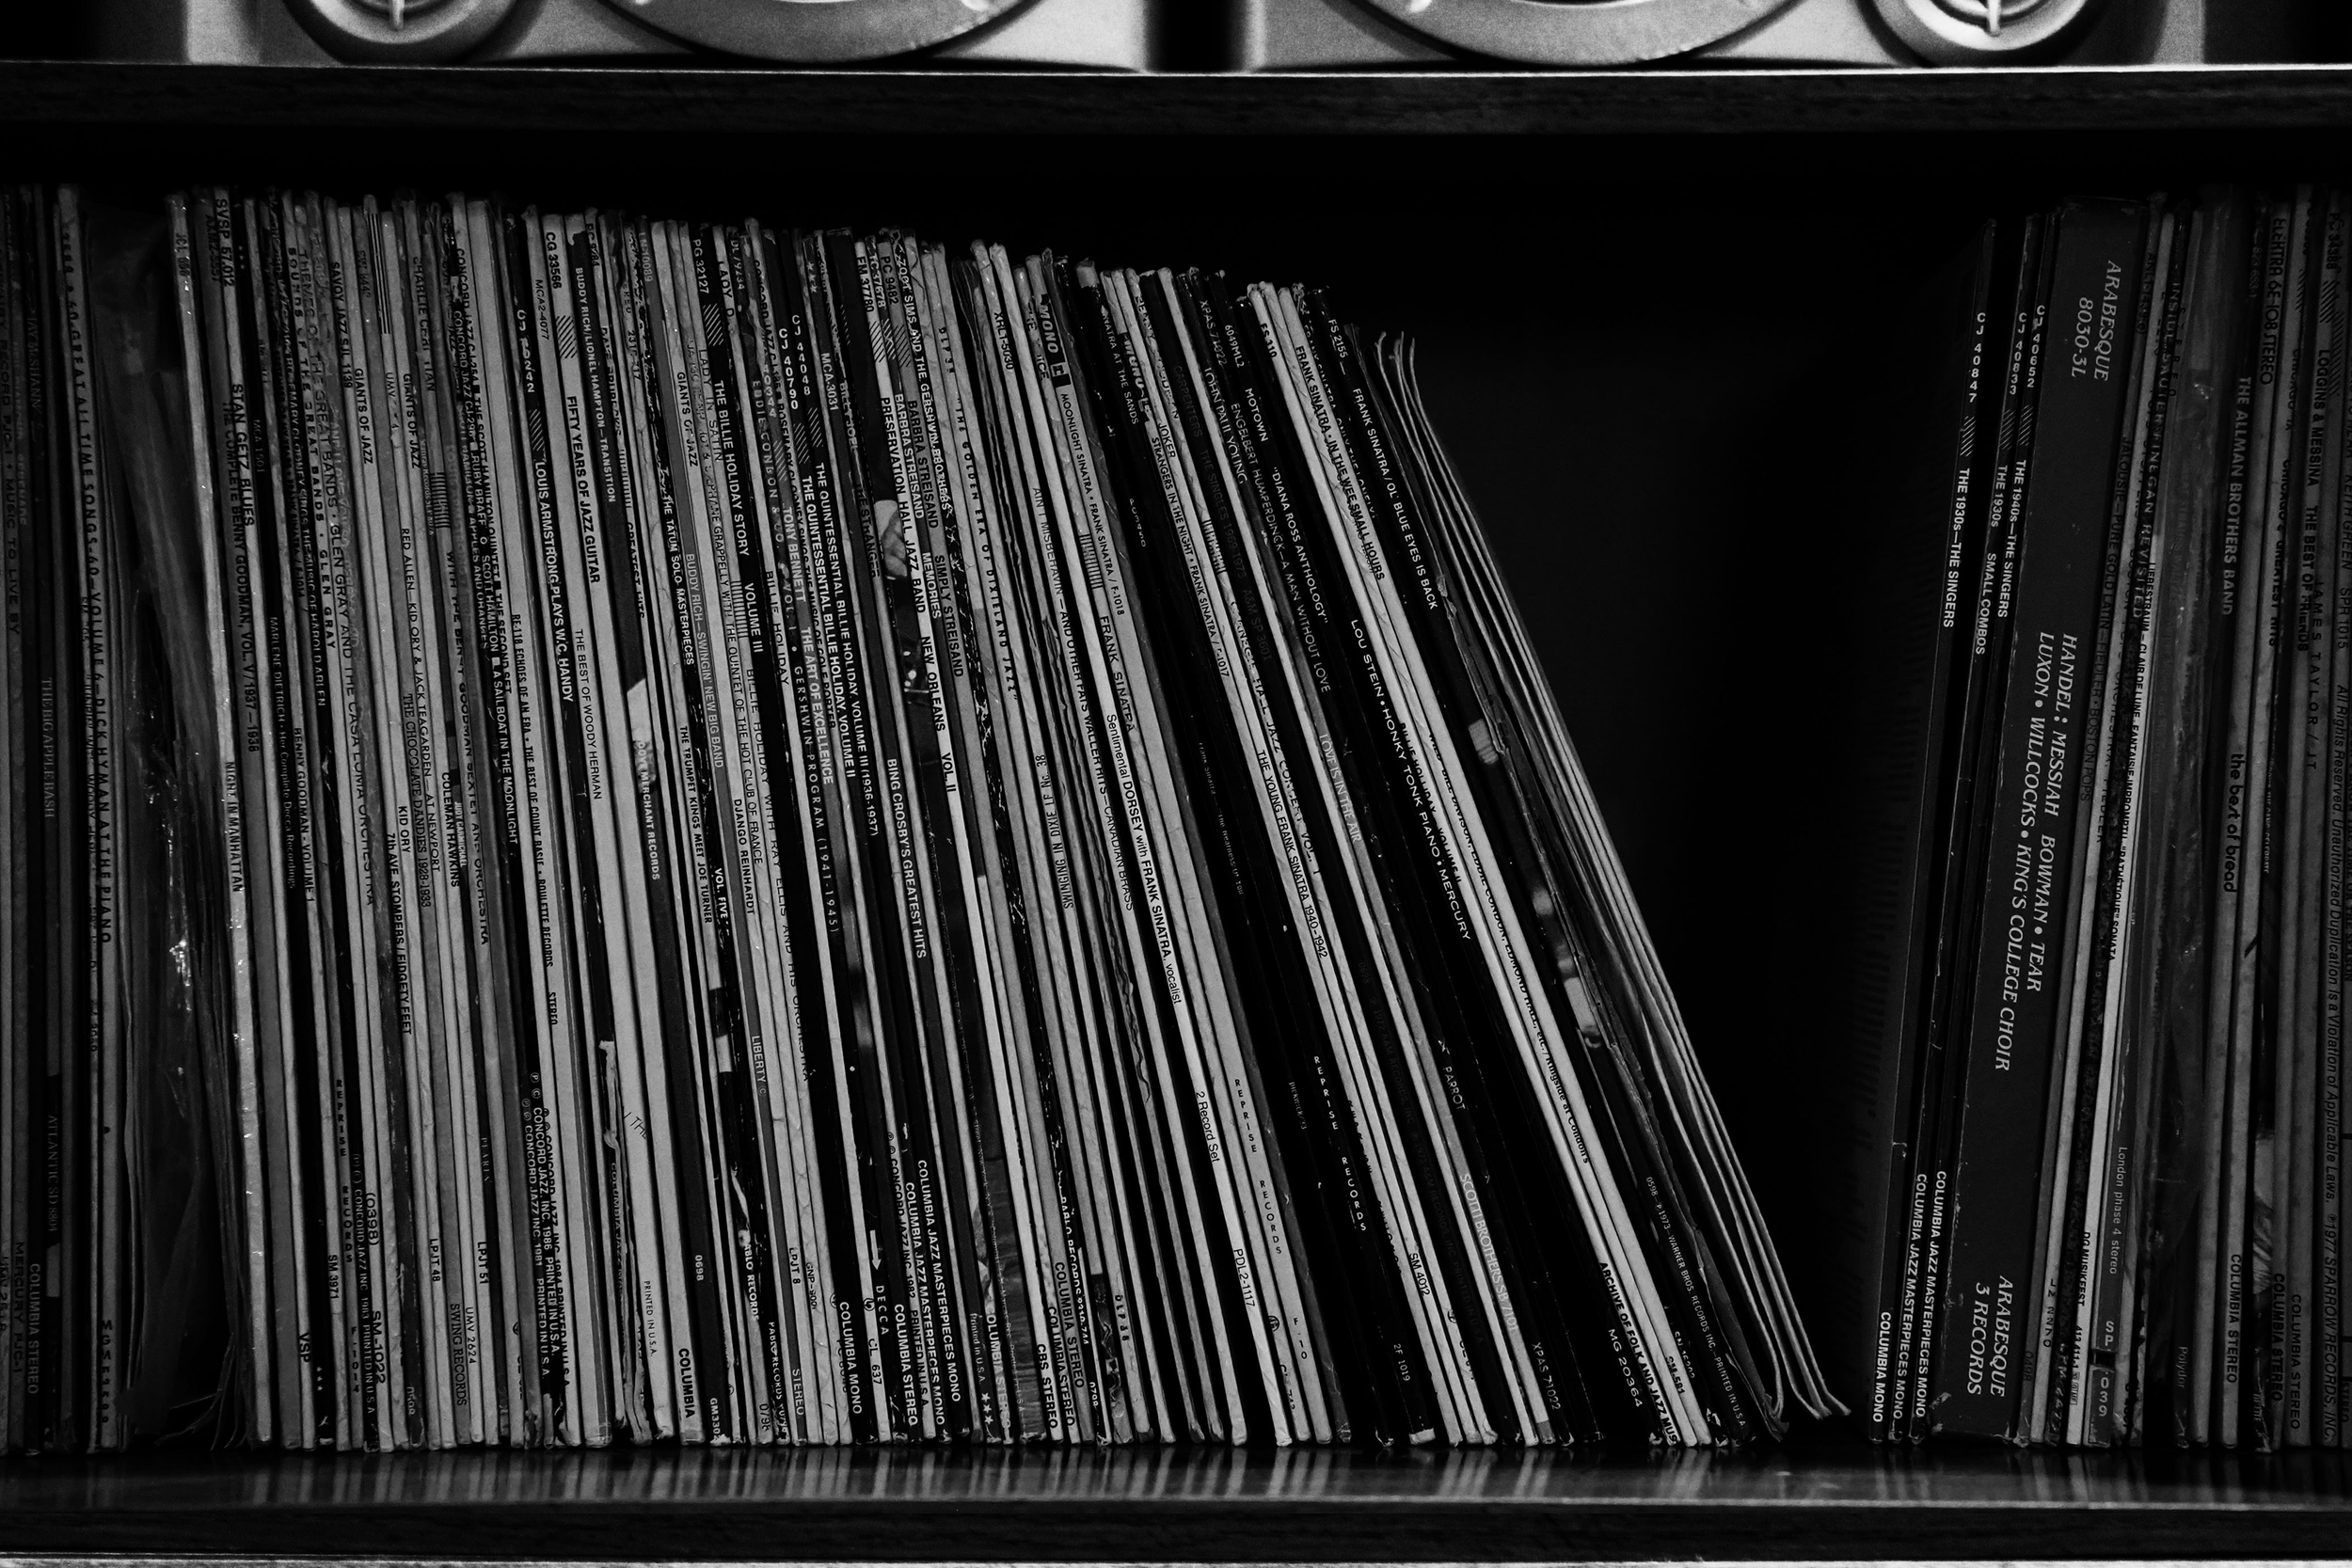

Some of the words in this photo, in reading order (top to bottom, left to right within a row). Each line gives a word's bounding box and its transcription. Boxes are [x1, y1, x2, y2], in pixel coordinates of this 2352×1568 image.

[544, 230, 558, 251] CG
[691, 238, 704, 258] PG
[328, 261, 345, 302] SAVOY
[547, 253, 564, 290] 33566
[693, 259, 709, 294] 32127
[333, 305, 348, 335] JAZZ
[2069, 296, 2094, 378] 8030-3L
[2091, 260, 2122, 382] ARABESQUE
[336, 337, 351, 360] SJL
[339, 362, 354, 388] 1139
[353, 367, 369, 413] GIANTS
[712, 379, 728, 407] THE
[2235, 375, 2251, 405] THE
[2312, 348, 2330, 410] LOGGINS
[230, 383, 246, 423] STAN
[358, 415, 371, 432] OF
[565, 395, 581, 431] FIFTY
[1350, 388, 1374, 426] FRANK
[2311, 413, 2326, 422] &
[717, 409, 735, 450] BILLIE
[879, 396, 906, 493] PRESERVATION
[906, 400, 926, 450] BARBRA
[2230, 408, 2249, 477] ALLMAN
[234, 431, 250, 469] GETZ
[359, 434, 373, 464] JAZZ
[570, 433, 587, 476] YEARS
[1364, 428, 1391, 475] SINATRA
[2306, 425, 2325, 486] MESSINA
[533, 461, 549, 499] LOUIS
[576, 478, 590, 498] OF
[723, 451, 742, 505] HOLIDAY
[812, 462, 828, 487] THE
[914, 451, 940, 528] STREISAND
[2011, 458, 2026, 485] THE
[238, 477, 255, 526] BLUES
[579, 499, 595, 532] JAZZ
[897, 499, 913, 532] HALL
[1391, 501, 1411, 531] BLUE
[2223, 482, 2243, 563] BROTHERS
[538, 500, 560, 583] ARMSTRONG
[731, 507, 750, 556] STORY
[781, 507, 797, 541] TONY
[817, 489, 845, 597] QUINTESSENTIAL
[583, 534, 601, 583] GUITAR
[903, 539, 919, 571] JAZZ
[1402, 533, 1422, 562] EYES
[1412, 563, 1427, 575] IS
[787, 543, 807, 602] BENNETT
[932, 554, 952, 601] SIMPLY
[1417, 578, 1439, 610] BACK
[1996, 562, 2014, 618] SINGERS
[2218, 568, 2236, 615] BAND
[548, 585, 564, 626] PLAYS
[742, 581, 761, 636] VOLUME
[910, 577, 927, 613] BAND
[267, 615, 282, 668] MARLENE
[573, 628, 586, 651] THE
[799, 626, 815, 652] THE
[834, 599, 850, 641] BILLIE
[941, 604, 965, 677] STREISAND
[576, 653, 590, 680] BEST
[751, 640, 764, 653] III
[803, 654, 818, 679] ART
[919, 635, 935, 665] NEW
[2032, 630, 2056, 696] LUXON
[40, 676, 53, 707] THE
[271, 671, 286, 722] DIETRICH
[556, 657, 574, 702] HANDY
[579, 683, 592, 701] OF
[807, 682, 821, 699] OF
[40, 708, 53, 732] BIG
[401, 692, 415, 718] THE
[925, 671, 946, 732] ORLEANS
[276, 730, 288, 749] Her
[581, 703, 597, 748] WOODY
[810, 702, 834, 784] EXCELLENCE
[849, 701, 868, 752] VOLUME
[1104, 713, 1131, 779] Sentimental
[41, 734, 55, 780] APPLE
[277, 751, 292, 798] Complete
[404, 721, 422, 796] CHOCOLATE
[586, 750, 603, 800] HERMAN
[856, 754, 870, 767] III
[885, 757, 901, 789] BING
[939, 752, 955, 781] VOL.
[2018, 715, 2046, 827] WILLCOCKS
[2042, 729, 2068, 816] MESSIAH
[2228, 752, 2245, 780] the
[42, 781, 56, 817] BASH
[944, 783, 957, 792] II
[1348, 619, 1369, 649] LOU
[1360, 653, 1386, 697] STEIN
[1379, 706, 1408, 760] HONKY
[1399, 764, 1424, 807] TONK
[1416, 811, 1443, 858] PIANO
[1436, 869, 1472, 940] MERCURY
[280, 800, 294, 832] Decca
[858, 768, 881, 836] (1936-1937)
[1119, 780, 1144, 832] DORSEY
[2226, 784, 2244, 819] best
[410, 799, 427, 853] DANDIES
[890, 792, 912, 857] CROSBY'S
[1132, 833, 1150, 857] with
[2224, 823, 2241, 841] of
[282, 833, 297, 889] Recordings
[416, 856, 432, 908] 1928-1933
[1137, 859, 1160, 902] FRANK
[2010, 842, 2033, 910] KING'S
[2031, 833, 2058, 923] BOWMAN
[2221, 844, 2240, 893] bread
[900, 859, 923, 926] GREATEST
[911, 927, 928, 958] HITS
[2000, 913, 2026, 1003] COLLEGE
[1162, 962, 1184, 1004] vocalist
[2024, 941, 2046, 991] TEAR
[1993, 1006, 2016, 1071] CHOIR
[46, 1114, 58, 1184] ATLANTIC
[2114, 1146, 2129, 1187] London
[46, 1185, 58, 1204] SD
[1196, 1101, 1216, 1140] Record
[1206, 1142, 1222, 1163] Set
[1231, 1248, 1257, 1307] PDL2-1117
[1930, 1169, 1947, 1238] COLUMBIA
[2111, 1190, 2124, 1225] phase
[47, 1206, 58, 1232] 8804
[1926, 1240, 1941, 1273] JAZZ
[2106, 1239, 2121, 1275] stereo
[27, 1262, 40, 1335] COLUMBIA
[1974, 1280, 1992, 1295] 3
[448, 1302, 463, 1345] SWING
[837, 1301, 858, 1370] COLUMBIA
[1874, 1310, 1893, 1380] COLUMBIA
[1916, 1275, 1938, 1374] MASTERPIECES
[1987, 1275, 2014, 1397] ARABESQUE
[2289, 1293, 2303, 1368] COLUMBIA
[26, 1339, 40, 1394] STEREO
[1964, 1299, 1990, 1395] RECORDS
[451, 1347, 468, 1406] RECORDS
[676, 1347, 696, 1418] COLUMBIA
[846, 1372, 864, 1415] MONO
[1913, 1376, 1929, 1418] MONO
[1870, 1382, 1886, 1422] MONO
[2288, 1370, 2302, 1429] STEREO
